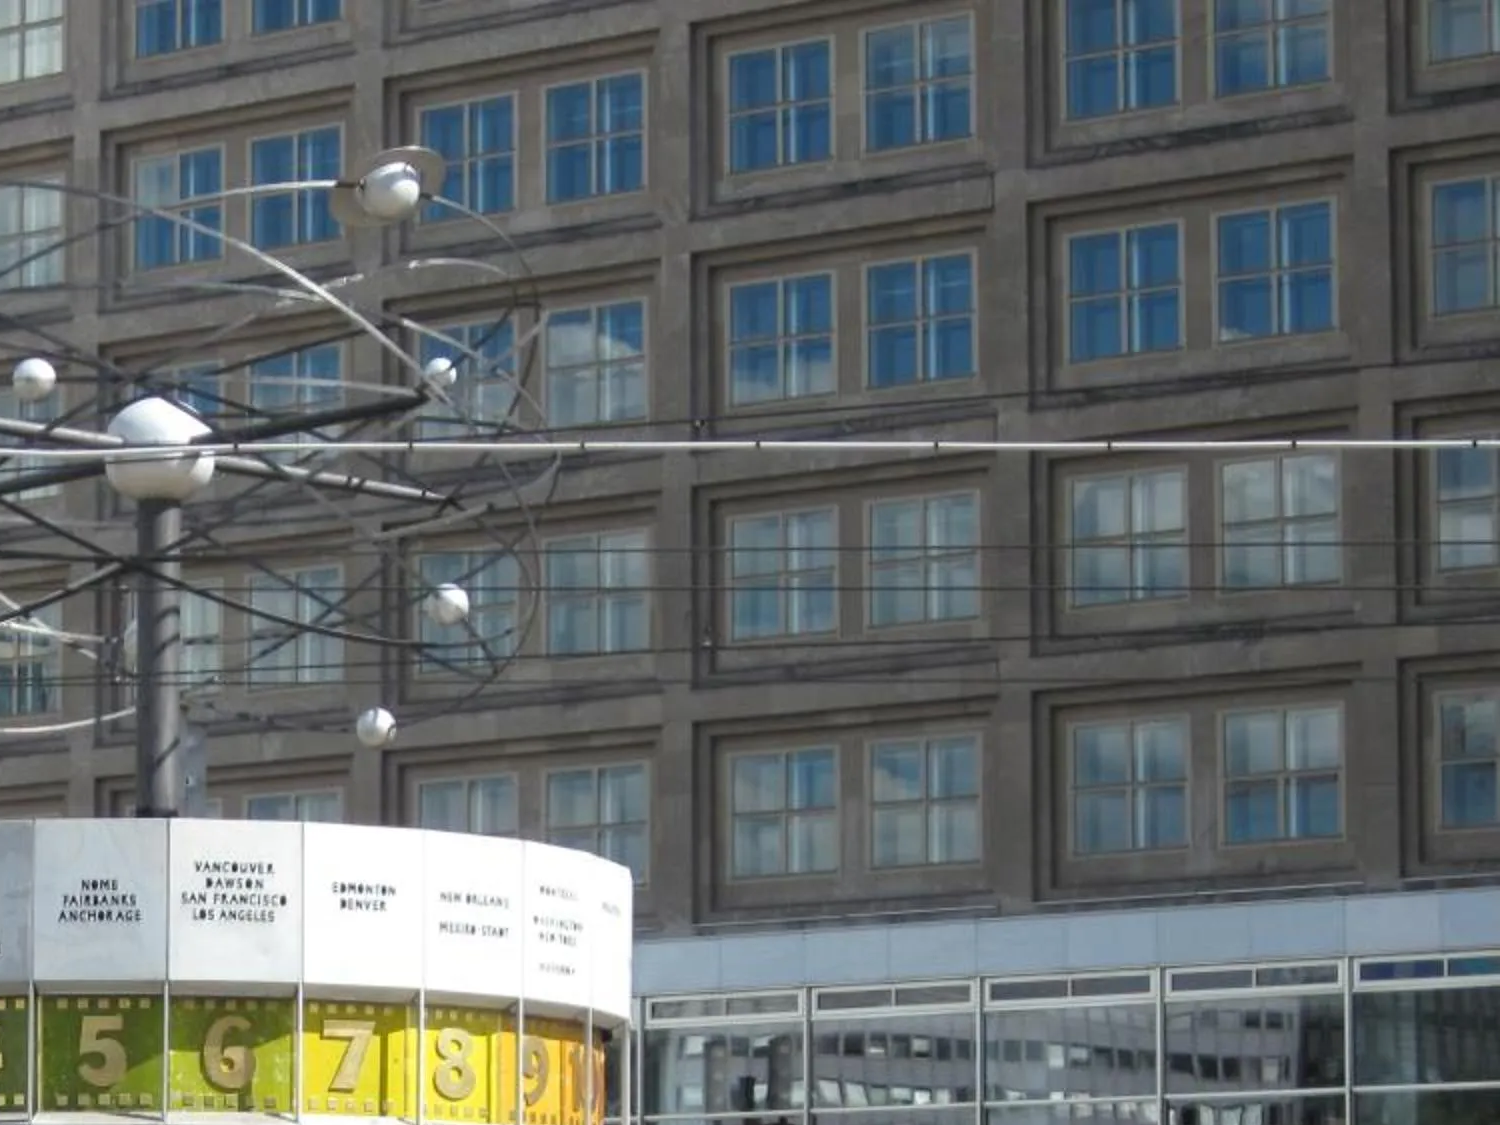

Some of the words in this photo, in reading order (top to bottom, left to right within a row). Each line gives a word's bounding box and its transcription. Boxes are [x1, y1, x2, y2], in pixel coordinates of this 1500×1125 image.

[195, 861, 274, 874] VANCOUVER
[81, 879, 119, 890] NOME
[205, 877, 264, 889] DAWSON
[332, 882, 396, 896] EDMONTON
[63, 894, 137, 907] FAIRBANKS
[181, 891, 207, 905] SAN
[213, 893, 288, 907] FRANCISCO
[340, 897, 387, 912] DENVER
[58, 909, 142, 922] ANCHORAGE
[192, 909, 215, 921] LOS
[219, 910, 276, 923] ANGELES
[78, 1015, 128, 1088] 5
[201, 1015, 256, 1093] 6
[320, 1018, 377, 1094] 7
[433, 1027, 477, 1102] 8
[521, 1034, 550, 1107] 9
